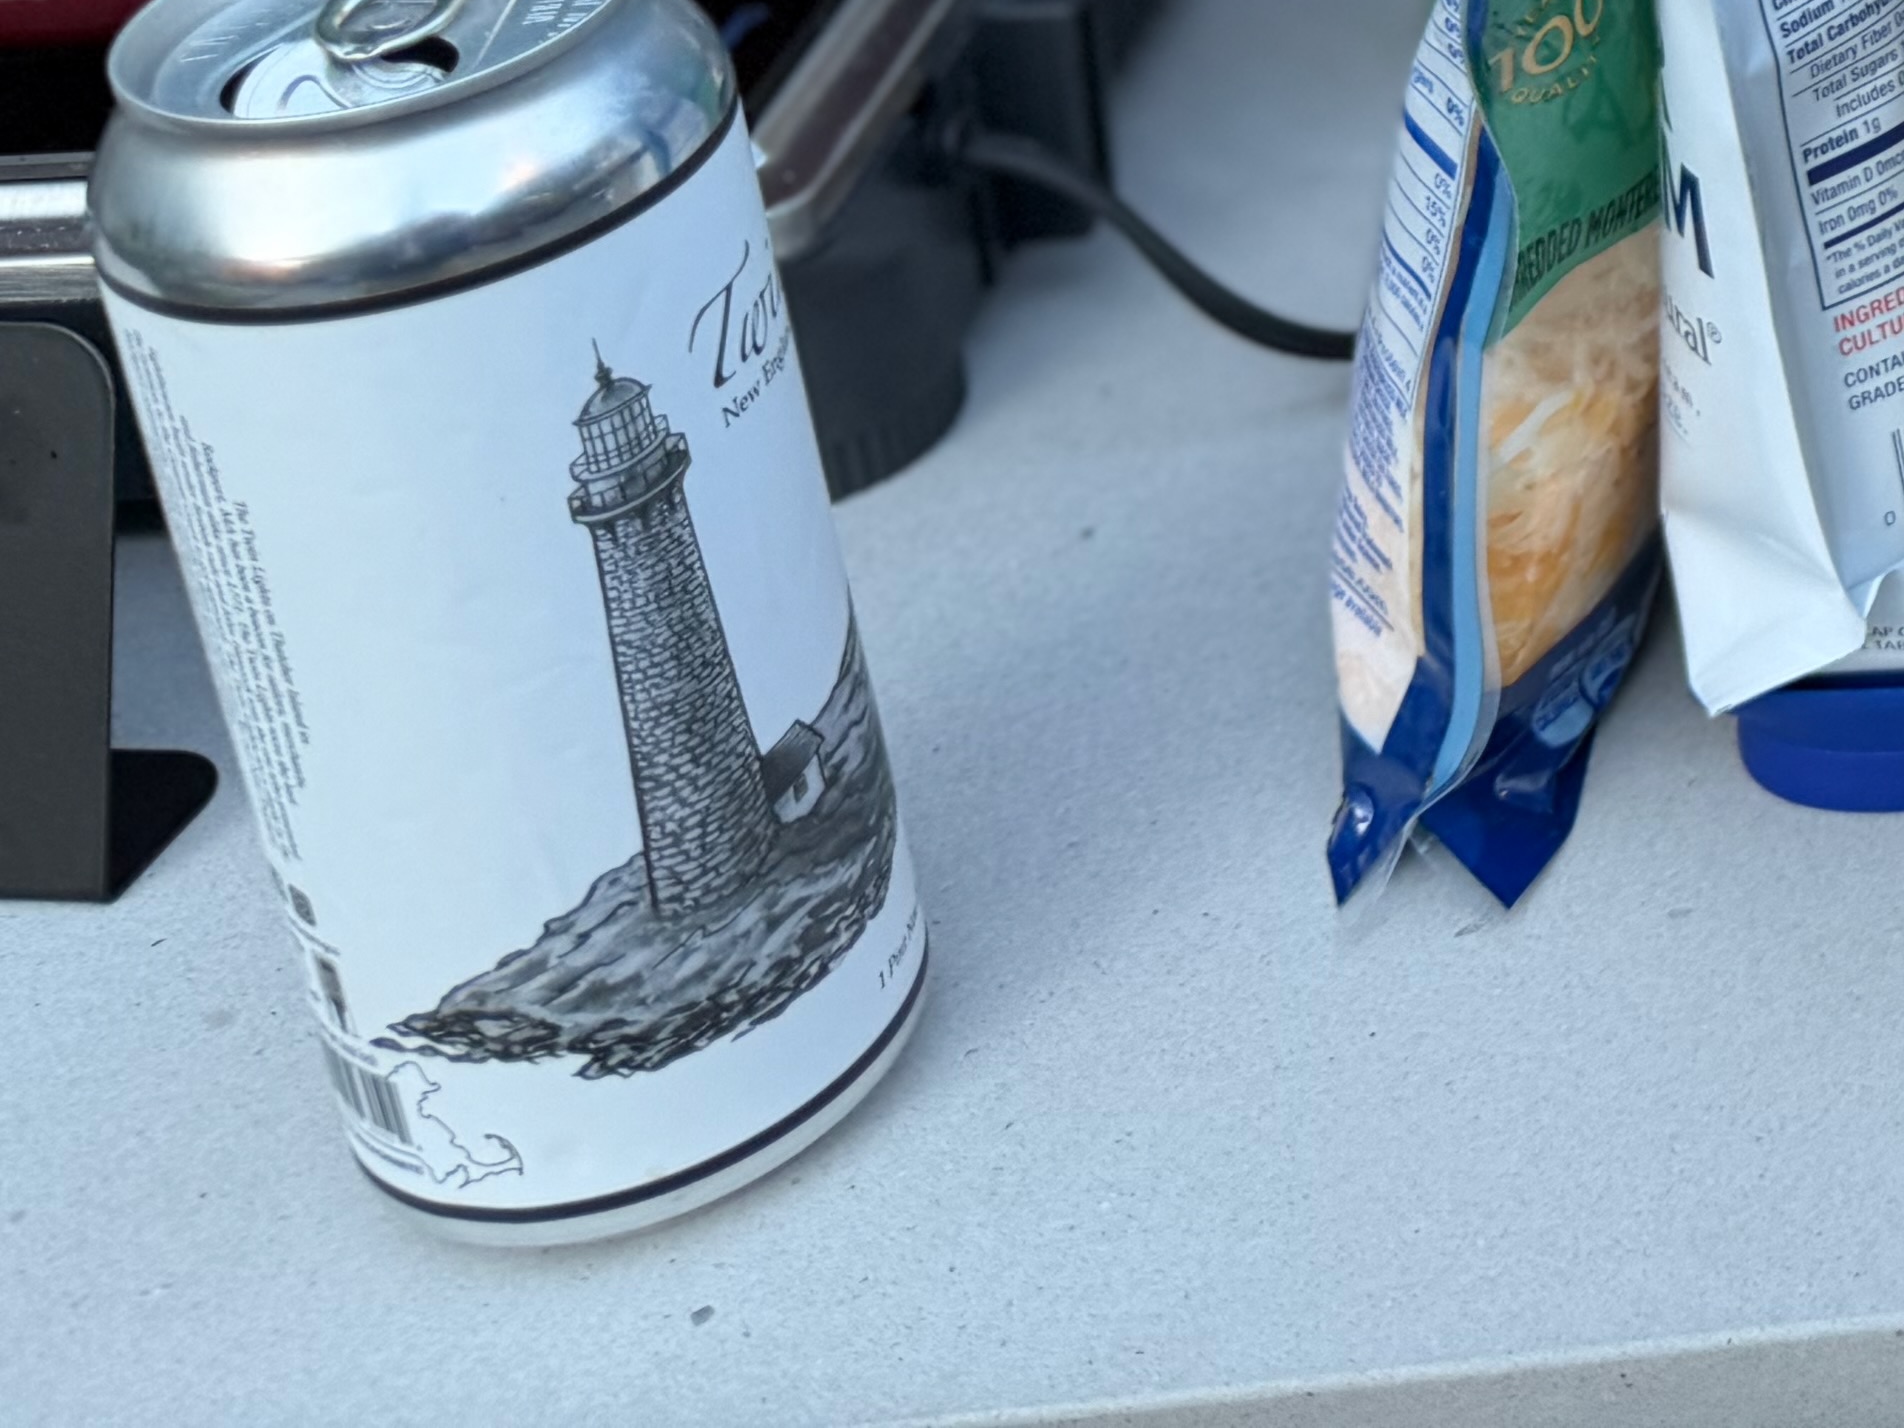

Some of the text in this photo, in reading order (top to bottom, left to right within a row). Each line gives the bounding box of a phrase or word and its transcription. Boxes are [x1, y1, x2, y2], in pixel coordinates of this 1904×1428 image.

[1786, 34, 1824, 65] Total
[1809, 45, 1857, 79] Dietary
[1861, 22, 1893, 50] Fiber
[1812, 51, 1898, 102] Total Sugars
[1835, 80, 1896, 118] Includes
[1802, 117, 1882, 164] Protein 1g
[1810, 172, 1861, 207] Vitamin
[1863, 165, 1874, 183] D
[1819, 197, 1877, 236] Iron 0mg
[1838, 269, 1882, 295] calories
[722, 379, 760, 428] New
[1883, 510, 1896, 527] 0
